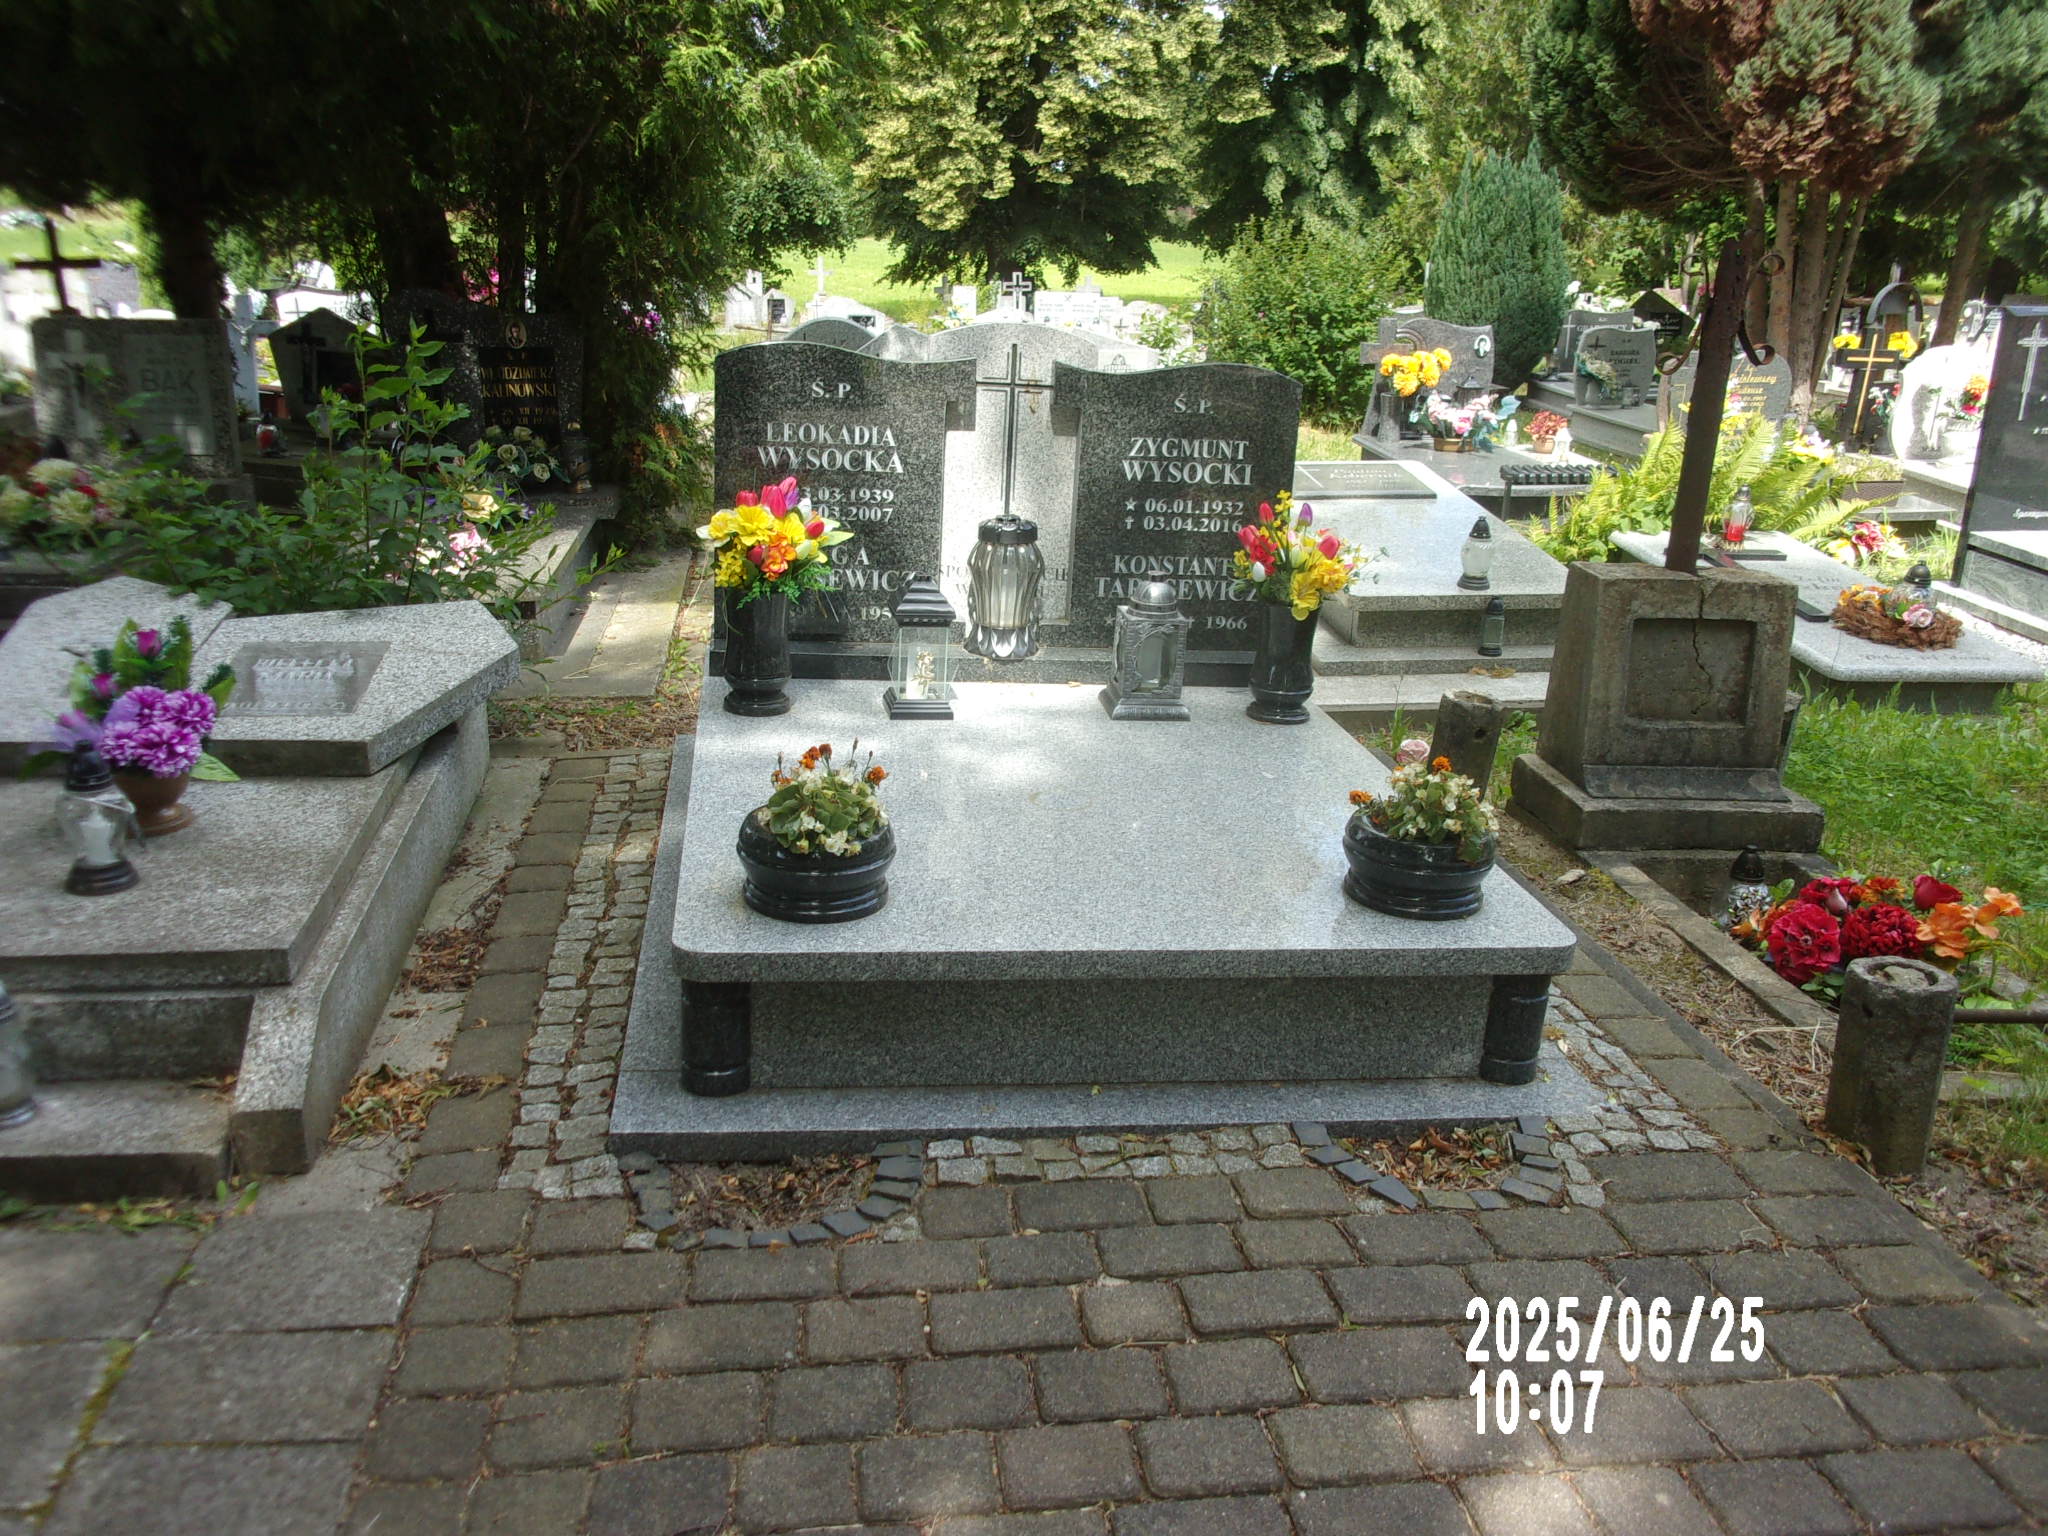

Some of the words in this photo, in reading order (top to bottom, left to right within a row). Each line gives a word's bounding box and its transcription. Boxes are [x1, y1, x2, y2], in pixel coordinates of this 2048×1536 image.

[482, 383, 556, 398] KALINOWSKI
[766, 421, 896, 447] LEOKADIA
[1128, 437, 1249, 460] ZYGMUNT
[757, 446, 904, 474] WYSOCKA
[1121, 459, 1253, 486] WYSOCKI
[800, 486, 895, 504] 3.03.1939
[1145, 498, 1244, 516] 06.01.1932
[1143, 516, 1242, 533] 03.04.2016
[1114, 554, 1235, 577] KONSTANT
[860, 606, 893, 621] 195
[1206, 615, 1248, 631] 1966
